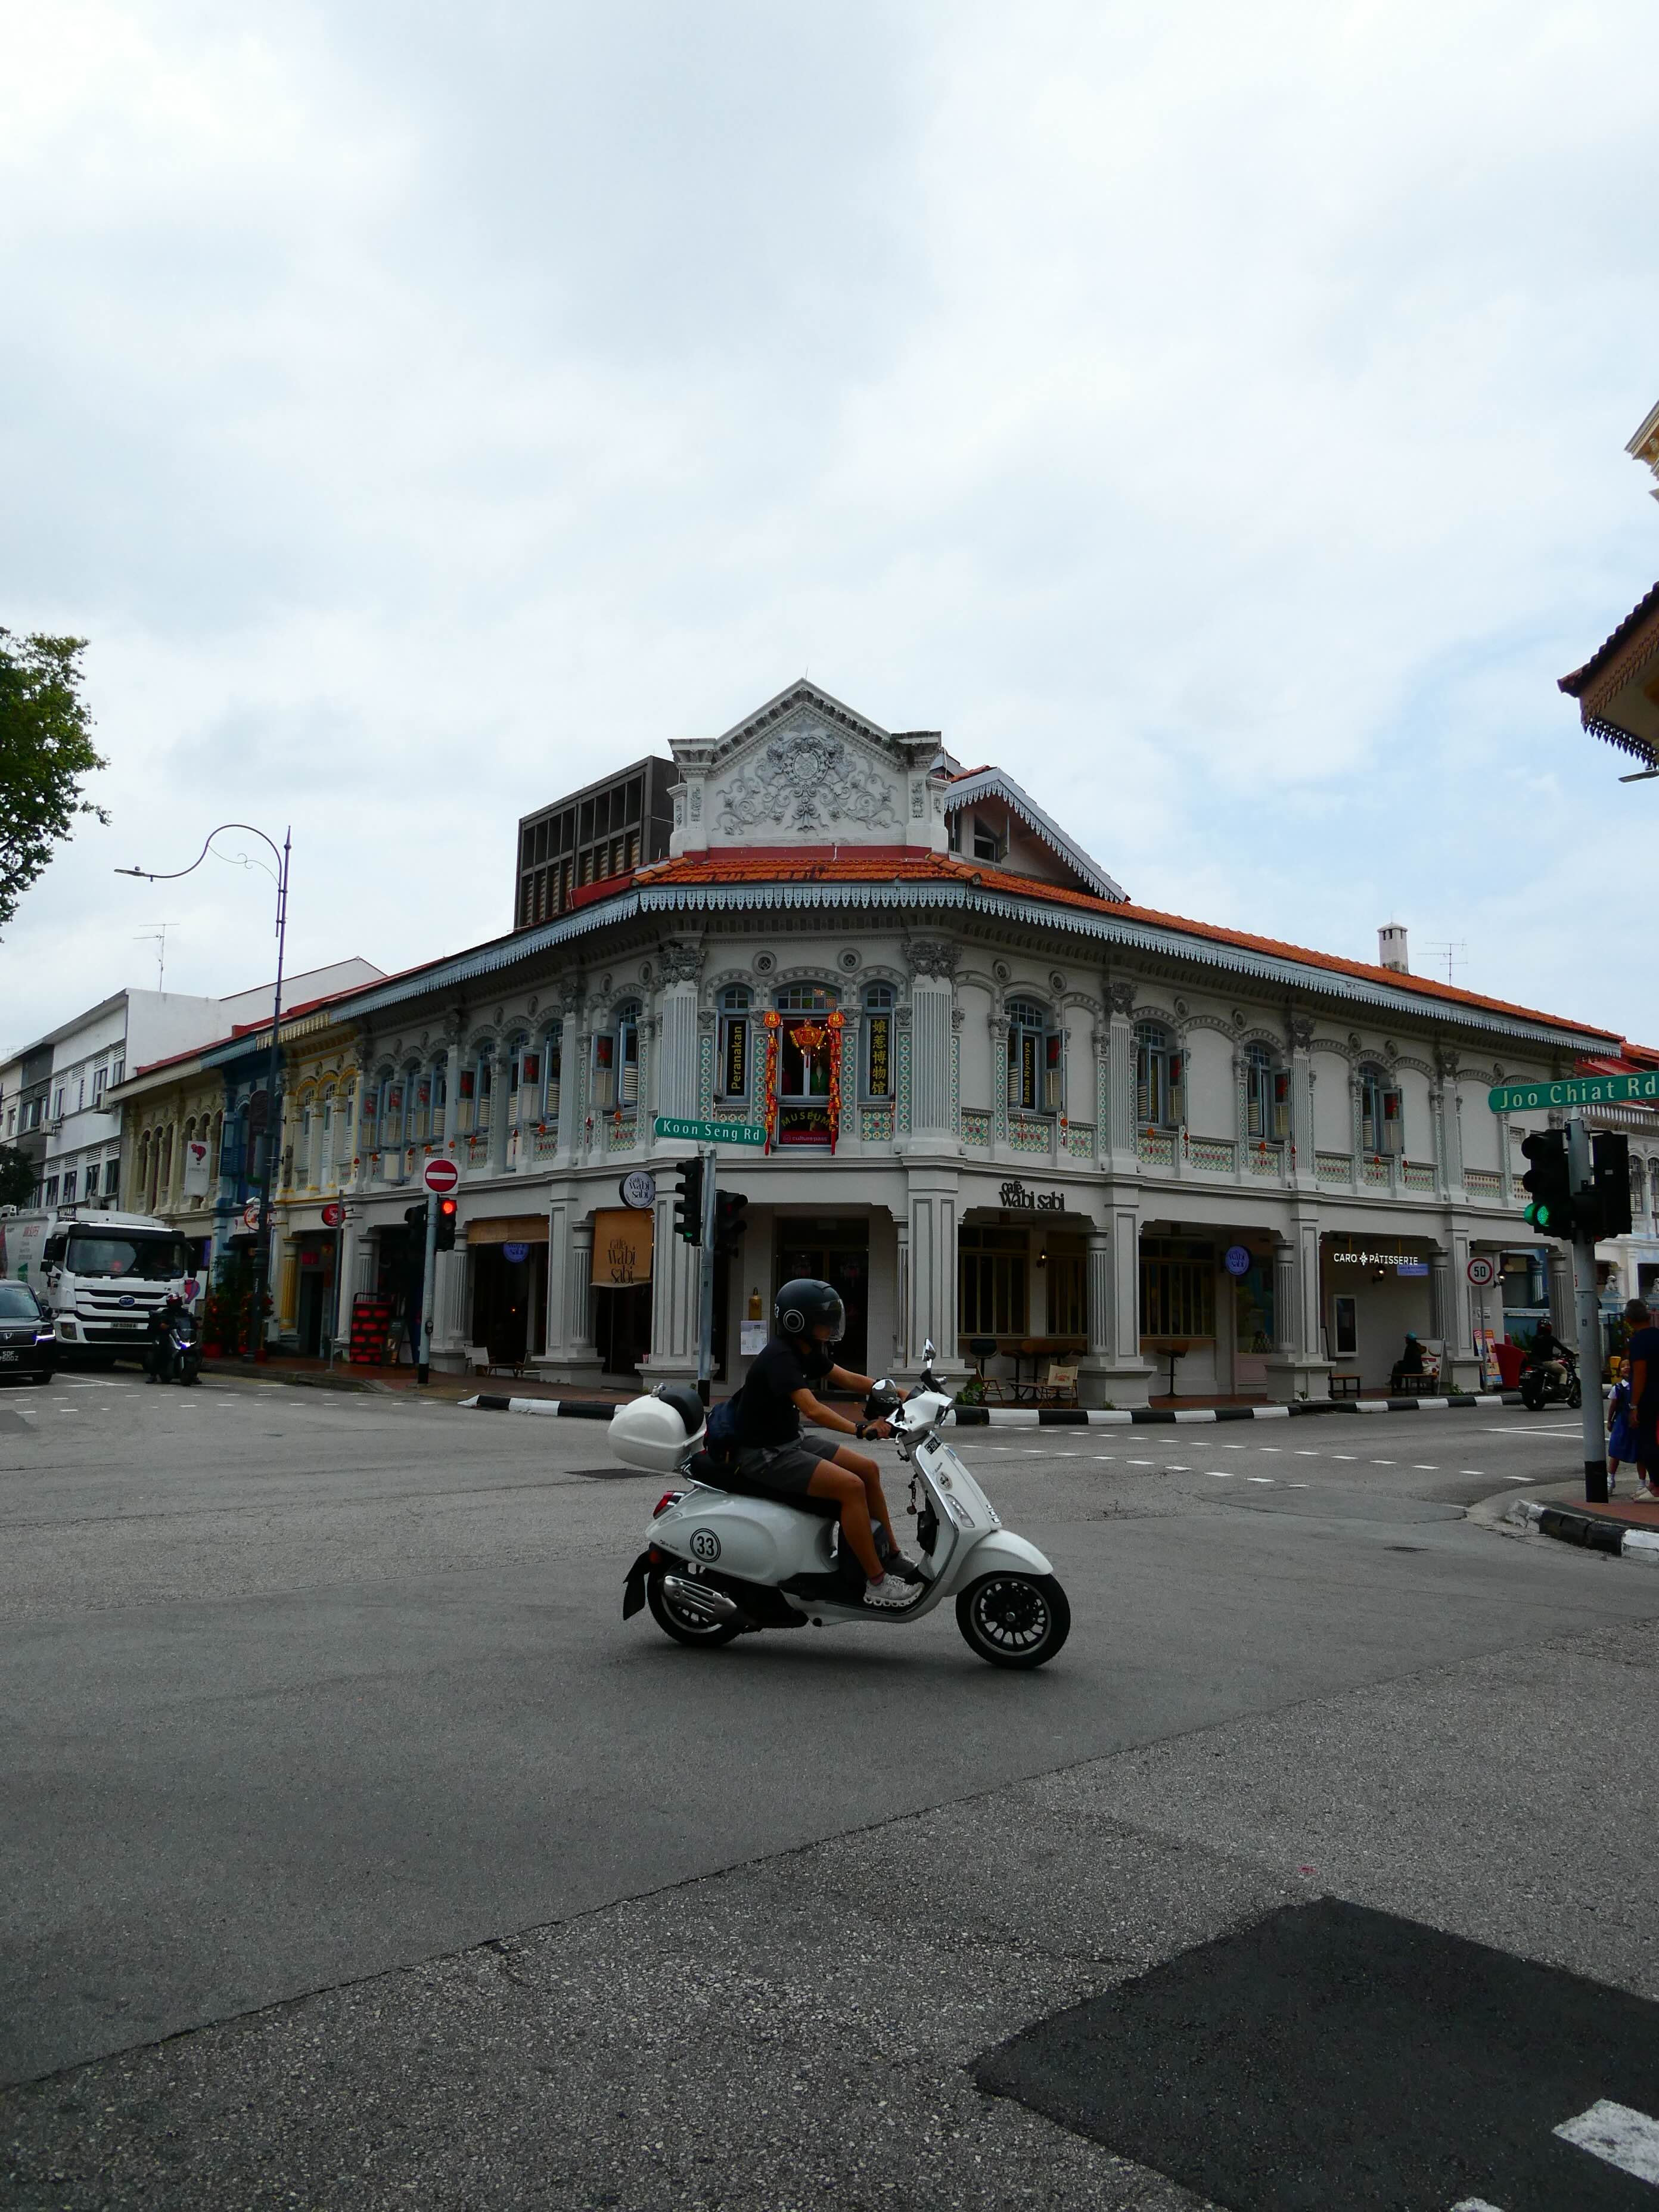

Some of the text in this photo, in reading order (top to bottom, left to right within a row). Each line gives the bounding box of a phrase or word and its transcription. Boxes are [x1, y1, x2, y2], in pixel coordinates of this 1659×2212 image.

[731, 1026, 742, 1090] Peranakan
[872, 1020, 887, 1095] 娘惹博物馆
[1500, 1076, 1656, 1109] Joo Chiat Rd
[782, 1111, 830, 1127] MUSEUM
[663, 1120, 760, 1142] Koon Seng Rd
[1037, 1191, 1065, 1211] sabi
[1334, 1253, 1419, 1266] CARO PÂTISSERIE
[611, 1265, 634, 1284] sabi
[1474, 1266, 1486, 1277] 50
[697, 1536, 714, 1556] 33
